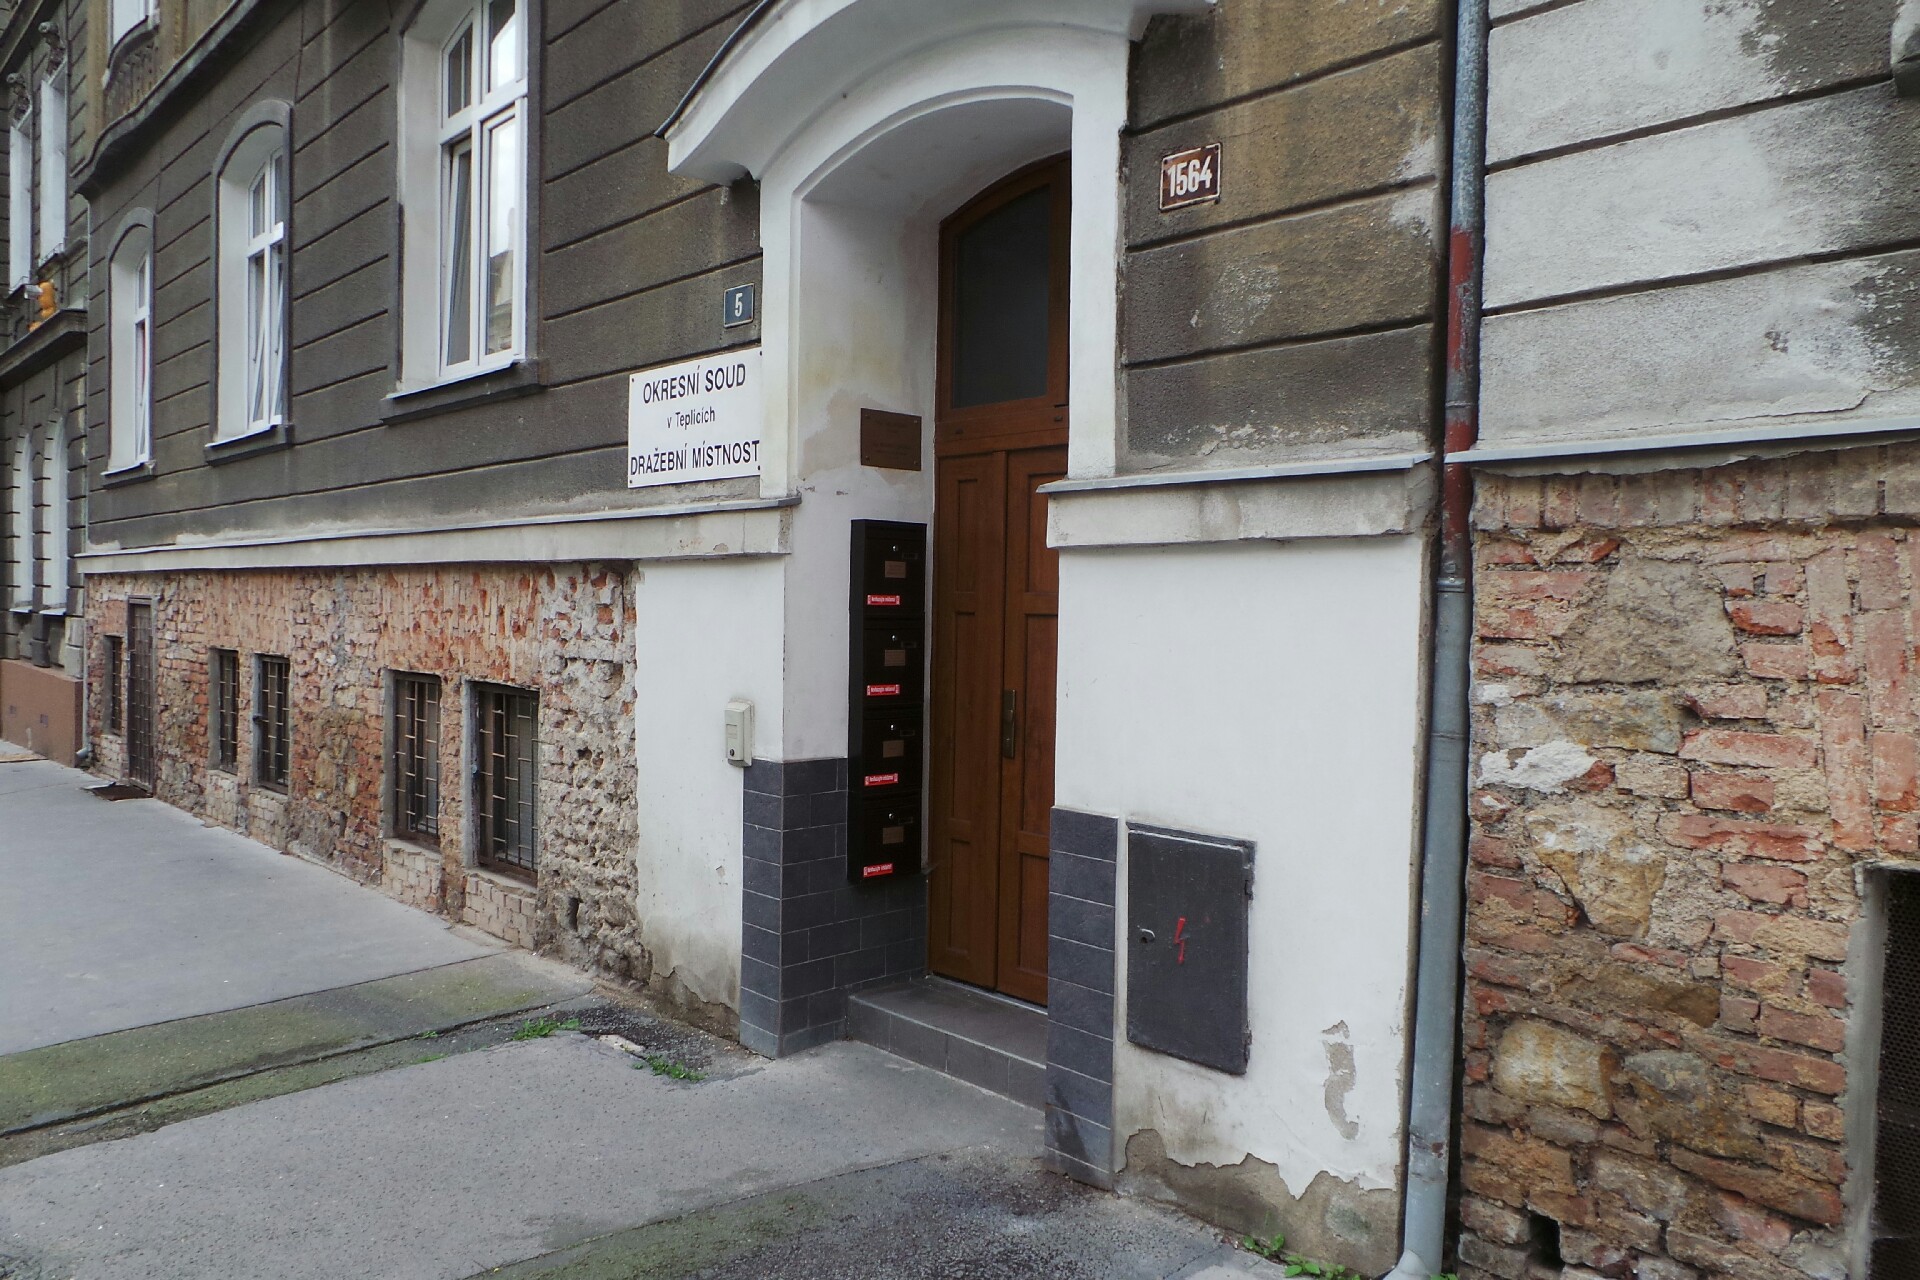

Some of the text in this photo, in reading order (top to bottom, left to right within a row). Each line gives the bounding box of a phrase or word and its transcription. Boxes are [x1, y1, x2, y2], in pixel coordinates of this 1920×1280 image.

[1167, 155, 1213, 198] 1564
[734, 292, 743, 317] 5
[643, 363, 746, 404] OKRESNÍ SOUD
[667, 406, 716, 430] v Teplicích
[630, 440, 760, 475] DRAŽEBNÍ MÍSTNOST
